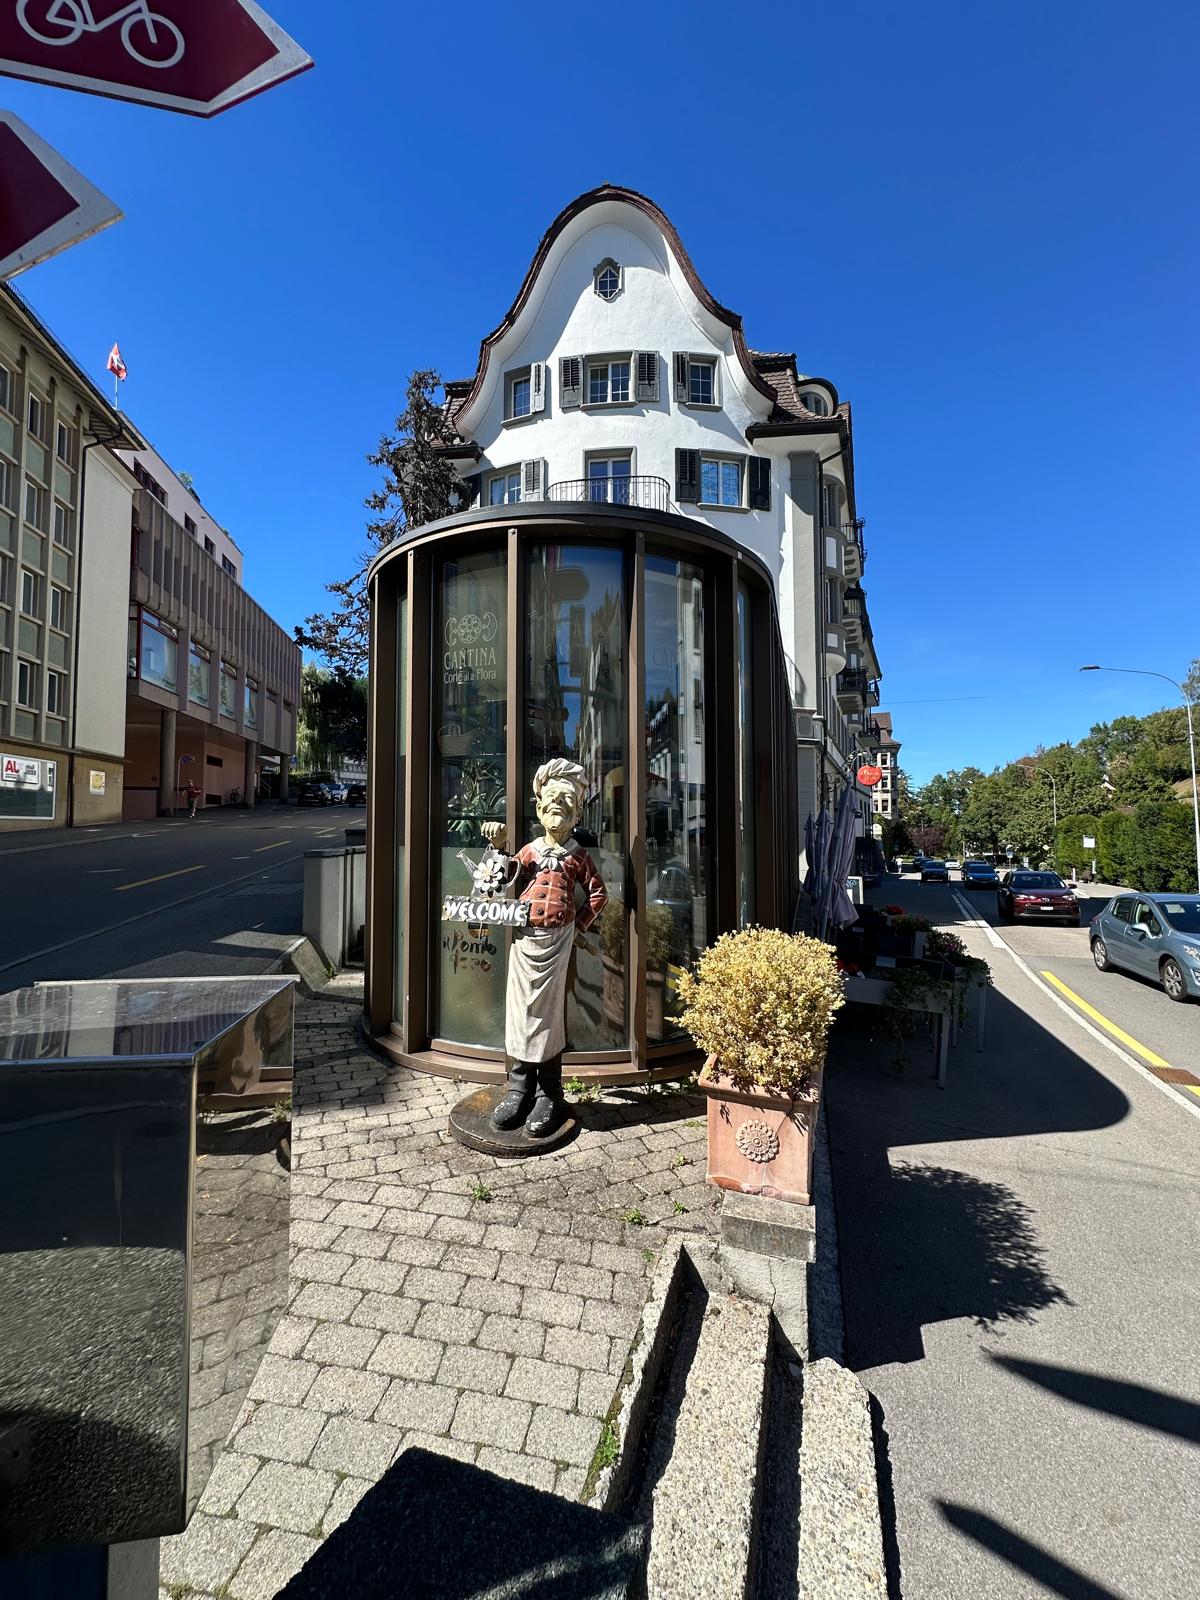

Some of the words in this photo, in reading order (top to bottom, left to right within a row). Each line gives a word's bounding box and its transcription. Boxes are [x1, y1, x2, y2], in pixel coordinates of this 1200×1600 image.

[444, 647, 497, 670] CANTINA
[476, 668, 497, 681] Flora
[445, 900, 528, 923] WELCOME
